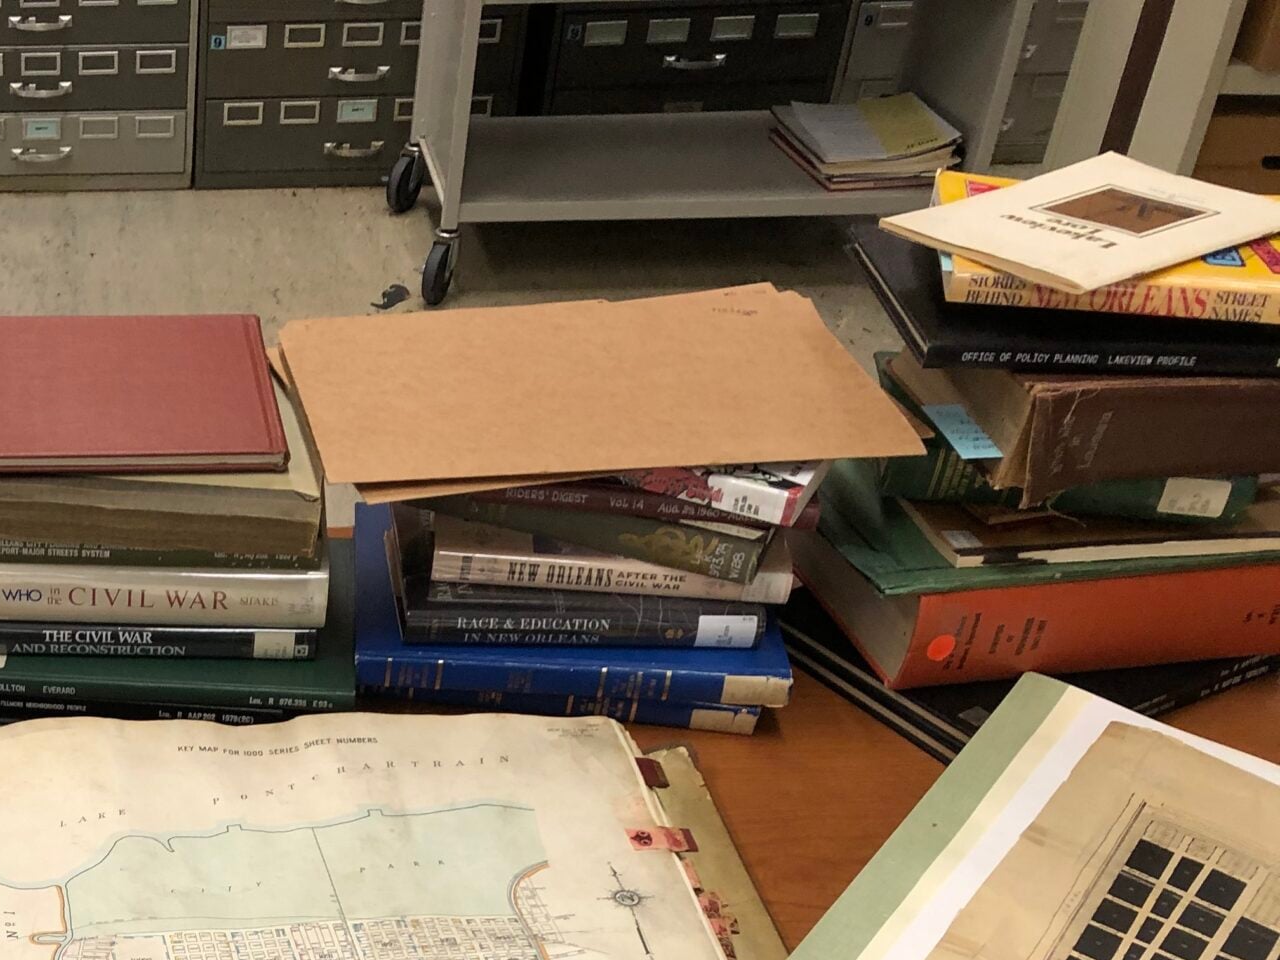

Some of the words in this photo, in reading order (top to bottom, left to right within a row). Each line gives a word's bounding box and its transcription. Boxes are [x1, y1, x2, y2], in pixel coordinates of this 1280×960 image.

[214, 37, 222, 48] 9
[965, 289, 1023, 306] BEHIND
[1210, 306, 1262, 322] NAMES
[1089, 281, 1209, 319] ORLEANS
[1216, 290, 1271, 307] STREET
[962, 352, 995, 362] OFFICE
[999, 352, 1012, 363] OF
[1016, 352, 1051, 365] POLICY
[1053, 353, 1098, 366] PLANNING
[1108, 354, 1152, 366] LAKEVIEW
[1157, 355, 1196, 367] PROFILE
[506, 488, 549, 500] RIDERS'
[552, 491, 588, 504] DIGEST
[48, 547, 78, 557] STREETS
[81, 548, 110, 558] SYSTEM
[507, 561, 540, 583] NEW
[546, 565, 614, 588] ORLEANS
[617, 571, 658, 581] AFTER
[663, 573, 687, 583] THE
[615, 580, 647, 590] CIVIL
[652, 581, 681, 591] WAR
[2, 588, 42, 602] WHO
[69, 586, 154, 608] CIVIL
[166, 589, 229, 610] WAR
[47, 596, 62, 605] the
[457, 617, 499, 629] RACE
[503, 617, 515, 629] &
[520, 617, 611, 632] EDUCATION
[42, 630, 72, 642] THE
[75, 630, 114, 643] CIVIL
[119, 630, 152, 644] WAR
[464, 633, 480, 642] IN
[486, 633, 521, 643] NEW
[525, 634, 600, 644] ORLEANS
[12, 643, 45, 653] AND
[50, 644, 186, 656] RECONSTRUCTION
[43, 685, 75, 695] EVERARD
[269, 746, 300, 755] SERIES
[304, 738, 331, 749] SHEET
[211, 752, 511, 805] PONTCHARTRAIN
